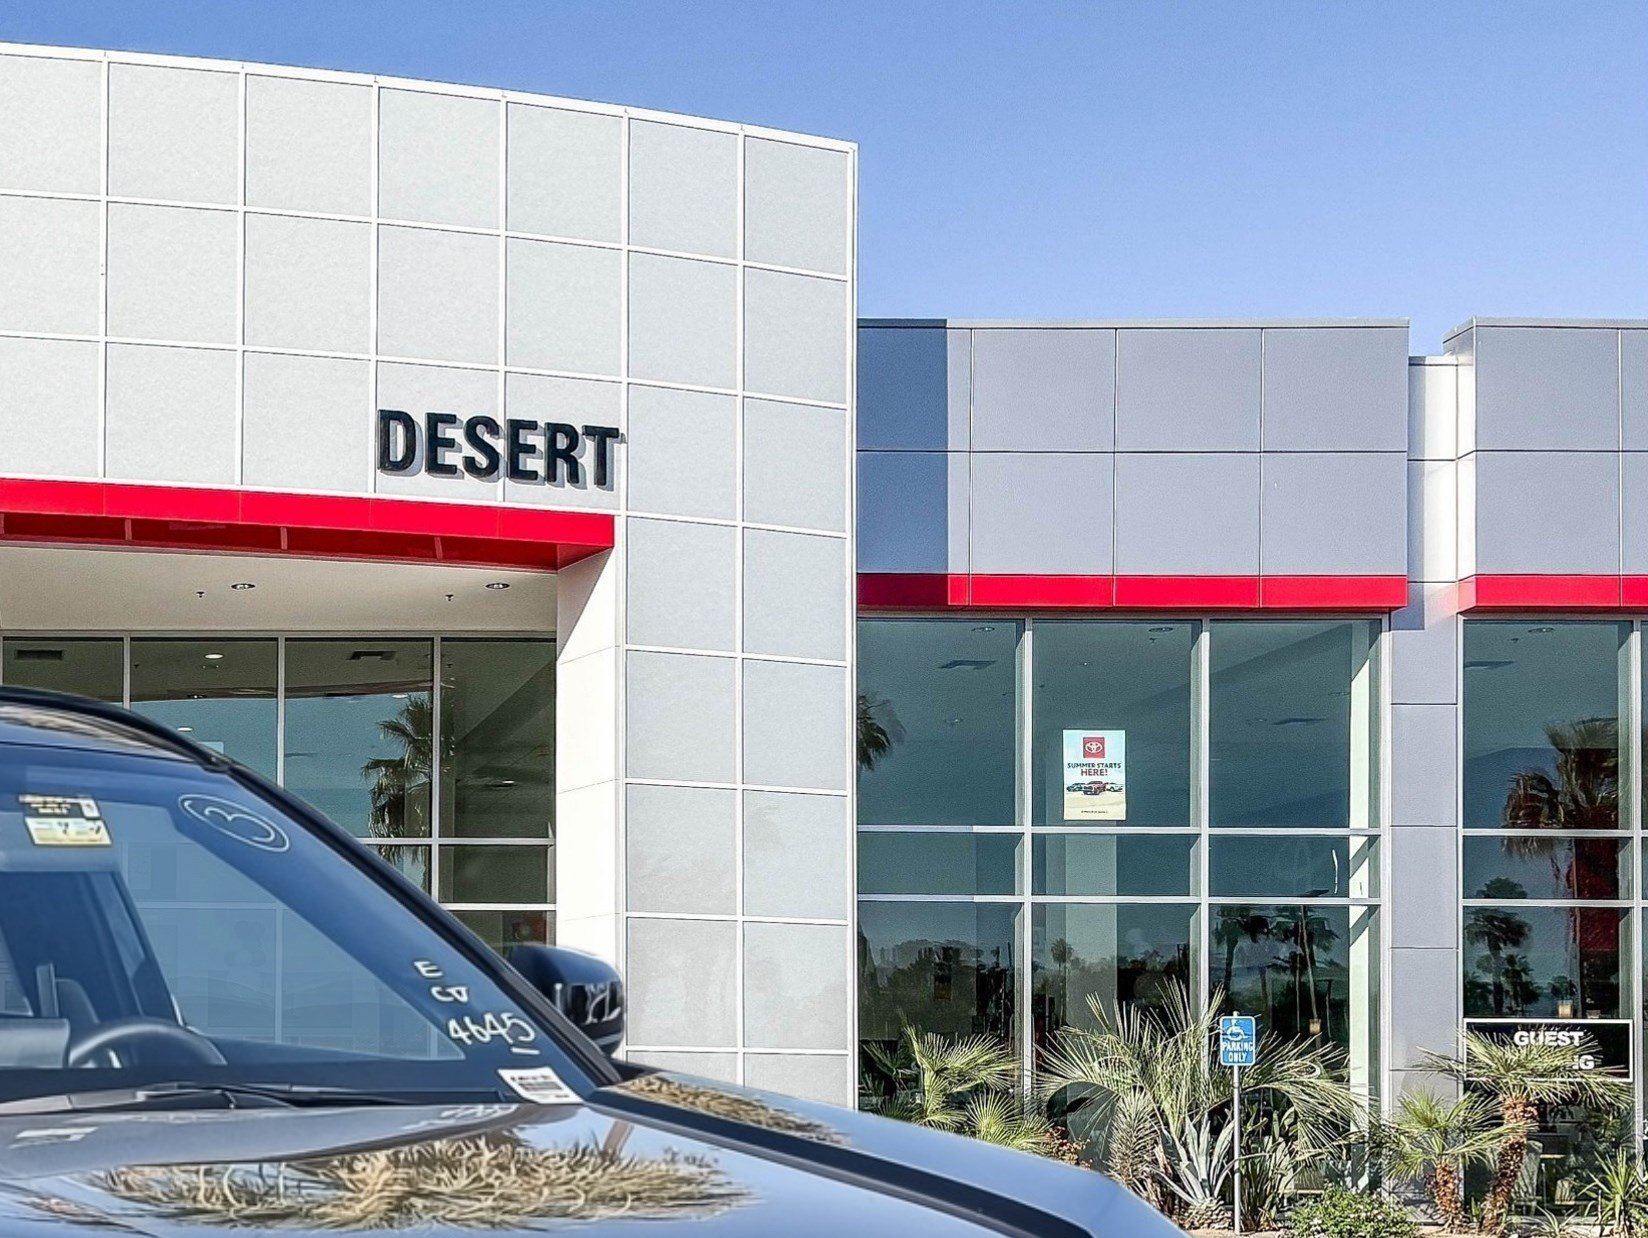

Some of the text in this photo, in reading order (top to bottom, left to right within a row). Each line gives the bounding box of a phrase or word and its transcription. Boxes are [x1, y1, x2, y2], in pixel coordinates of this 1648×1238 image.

[377, 409, 620, 486] DESERT
[414, 961, 443, 977] E
[1222, 1041, 1254, 1052] PARKING
[1513, 1031, 1584, 1047] GUEST
[1228, 1052, 1248, 1062] ONLY
